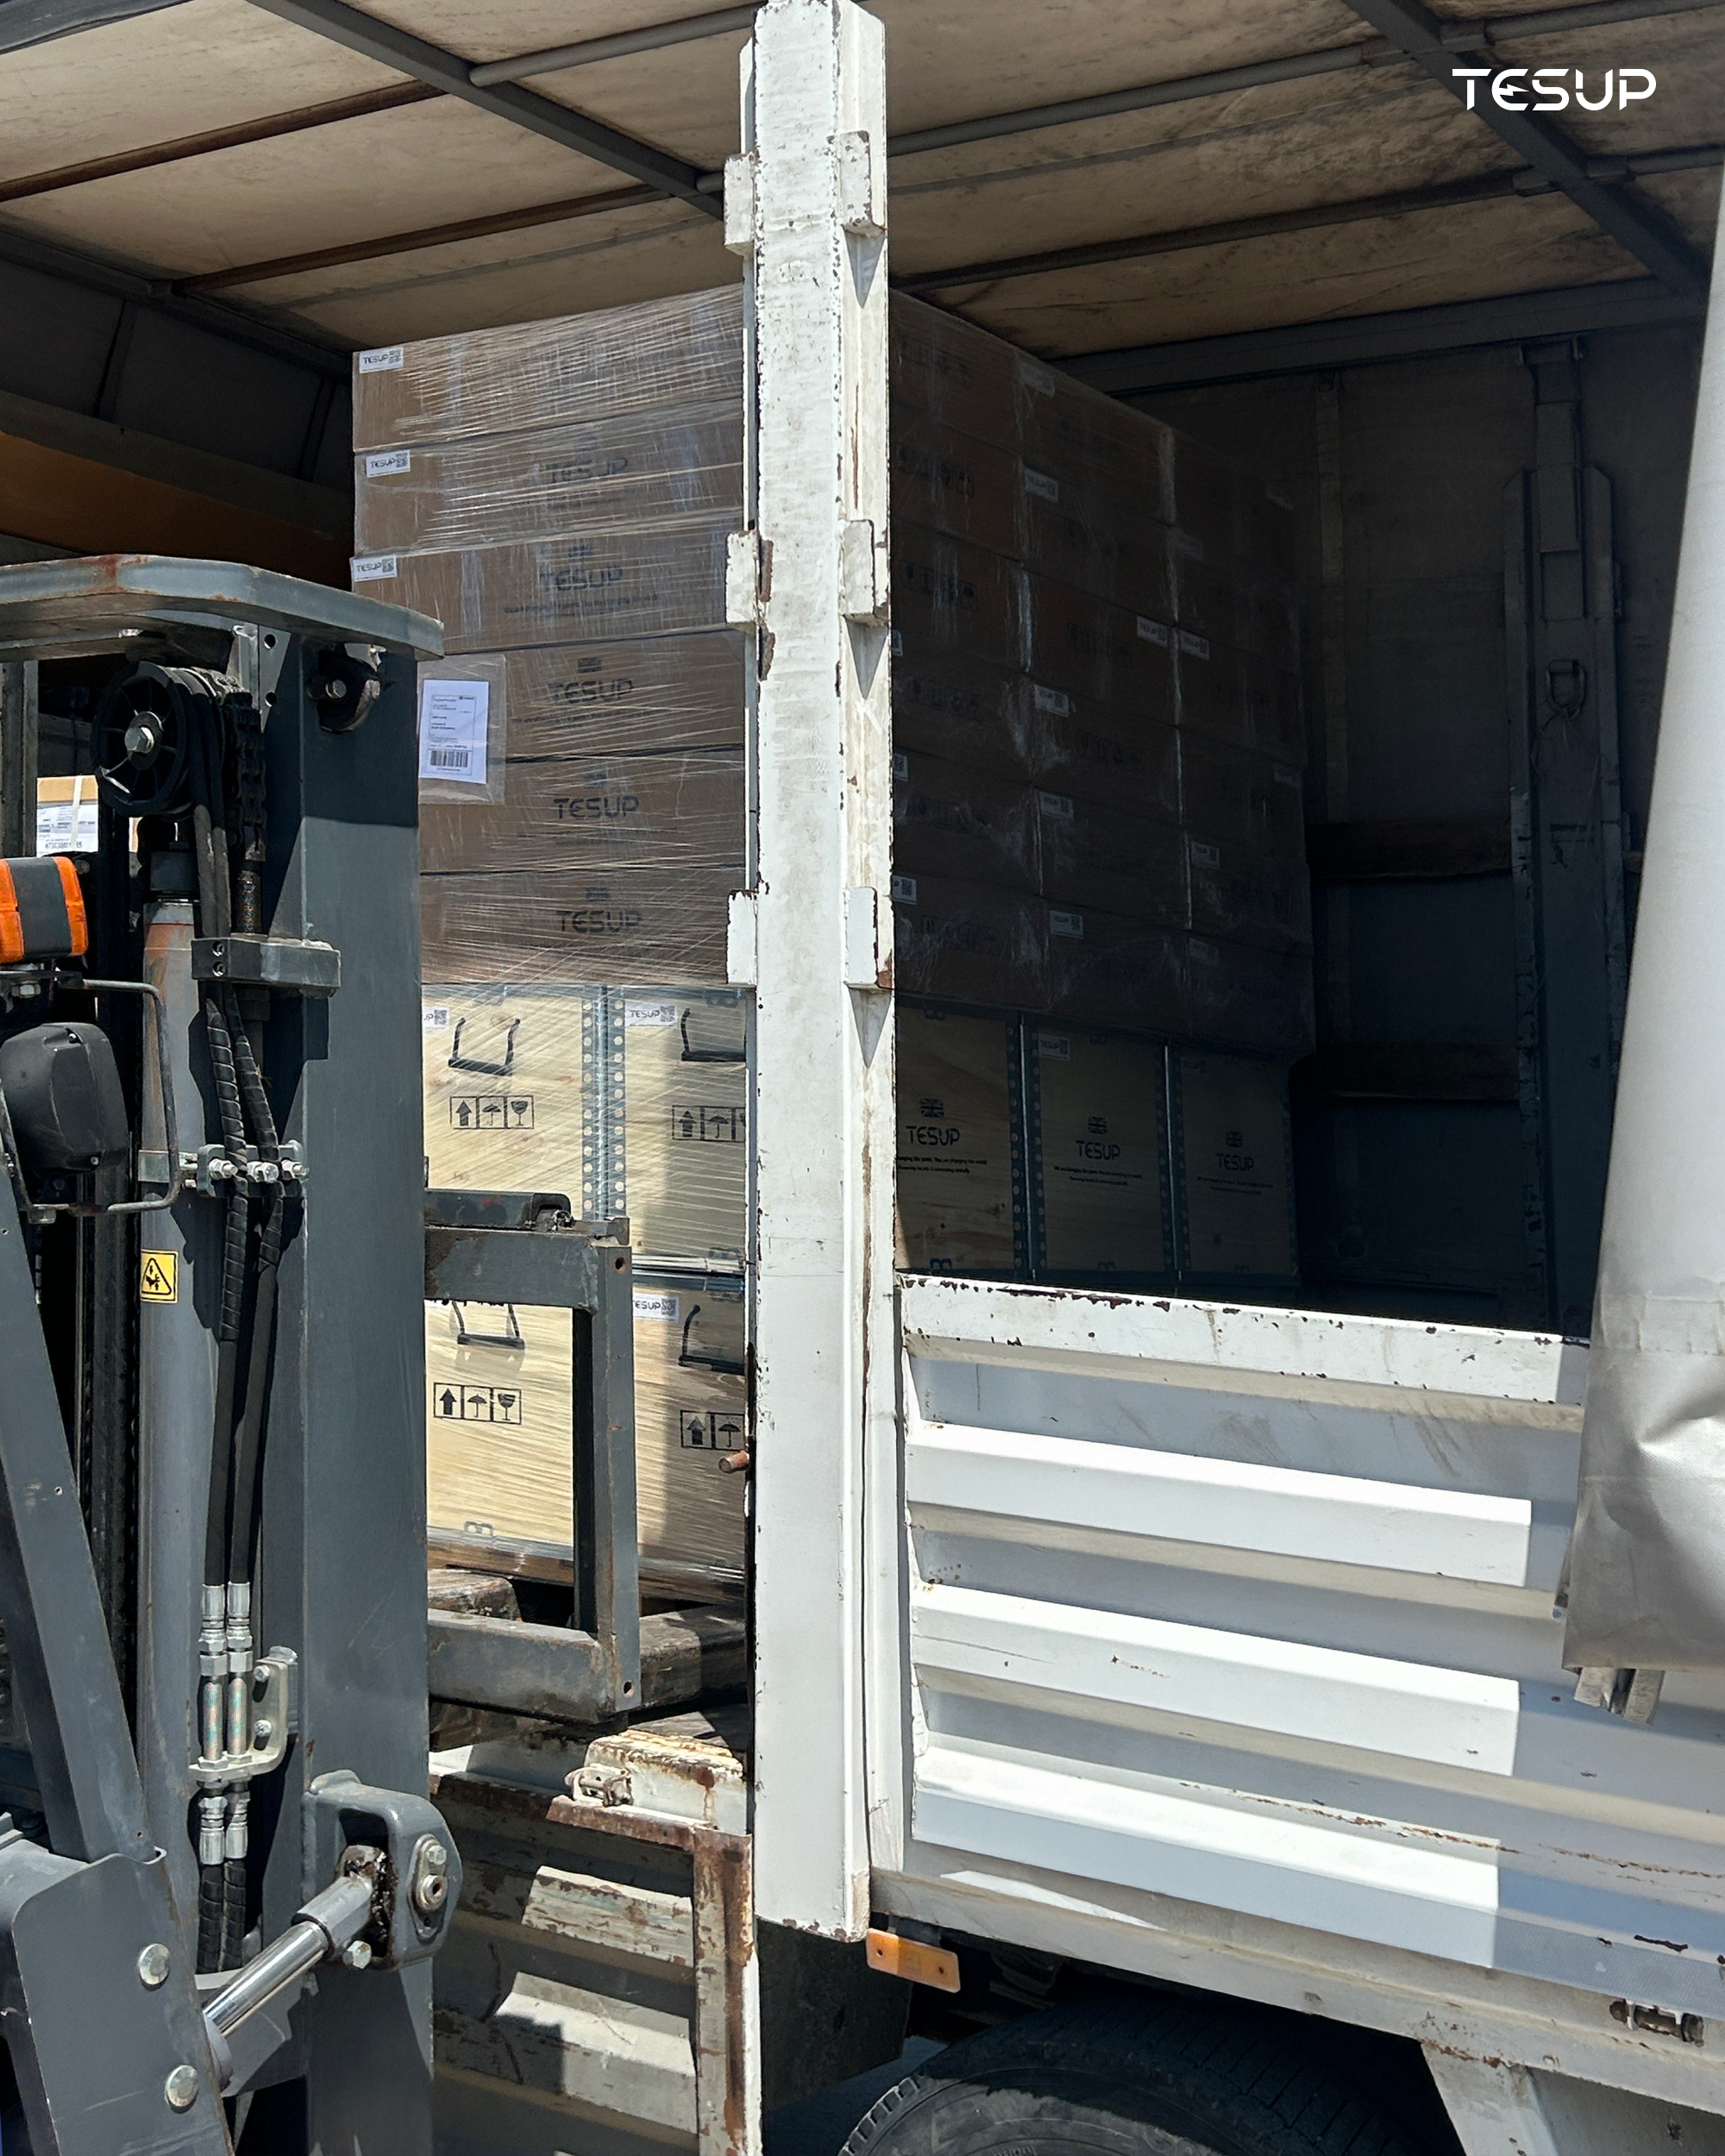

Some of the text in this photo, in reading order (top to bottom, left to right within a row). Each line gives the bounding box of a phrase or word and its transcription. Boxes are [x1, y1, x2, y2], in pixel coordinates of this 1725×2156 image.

[363, 354, 389, 364] TESUP
[370, 457, 396, 468] TESUP
[355, 561, 382, 573] TESUP
[547, 678, 635, 704] TESUP
[553, 795, 639, 819] TESUP
[556, 910, 643, 932] TESUP
[630, 1009, 660, 1018] TESUP
[906, 1125, 960, 1146] TESUP
[1076, 1140, 1120, 1160] TESUP
[1215, 1153, 1255, 1172] TESUP
[633, 1300, 662, 1310] ESUP
